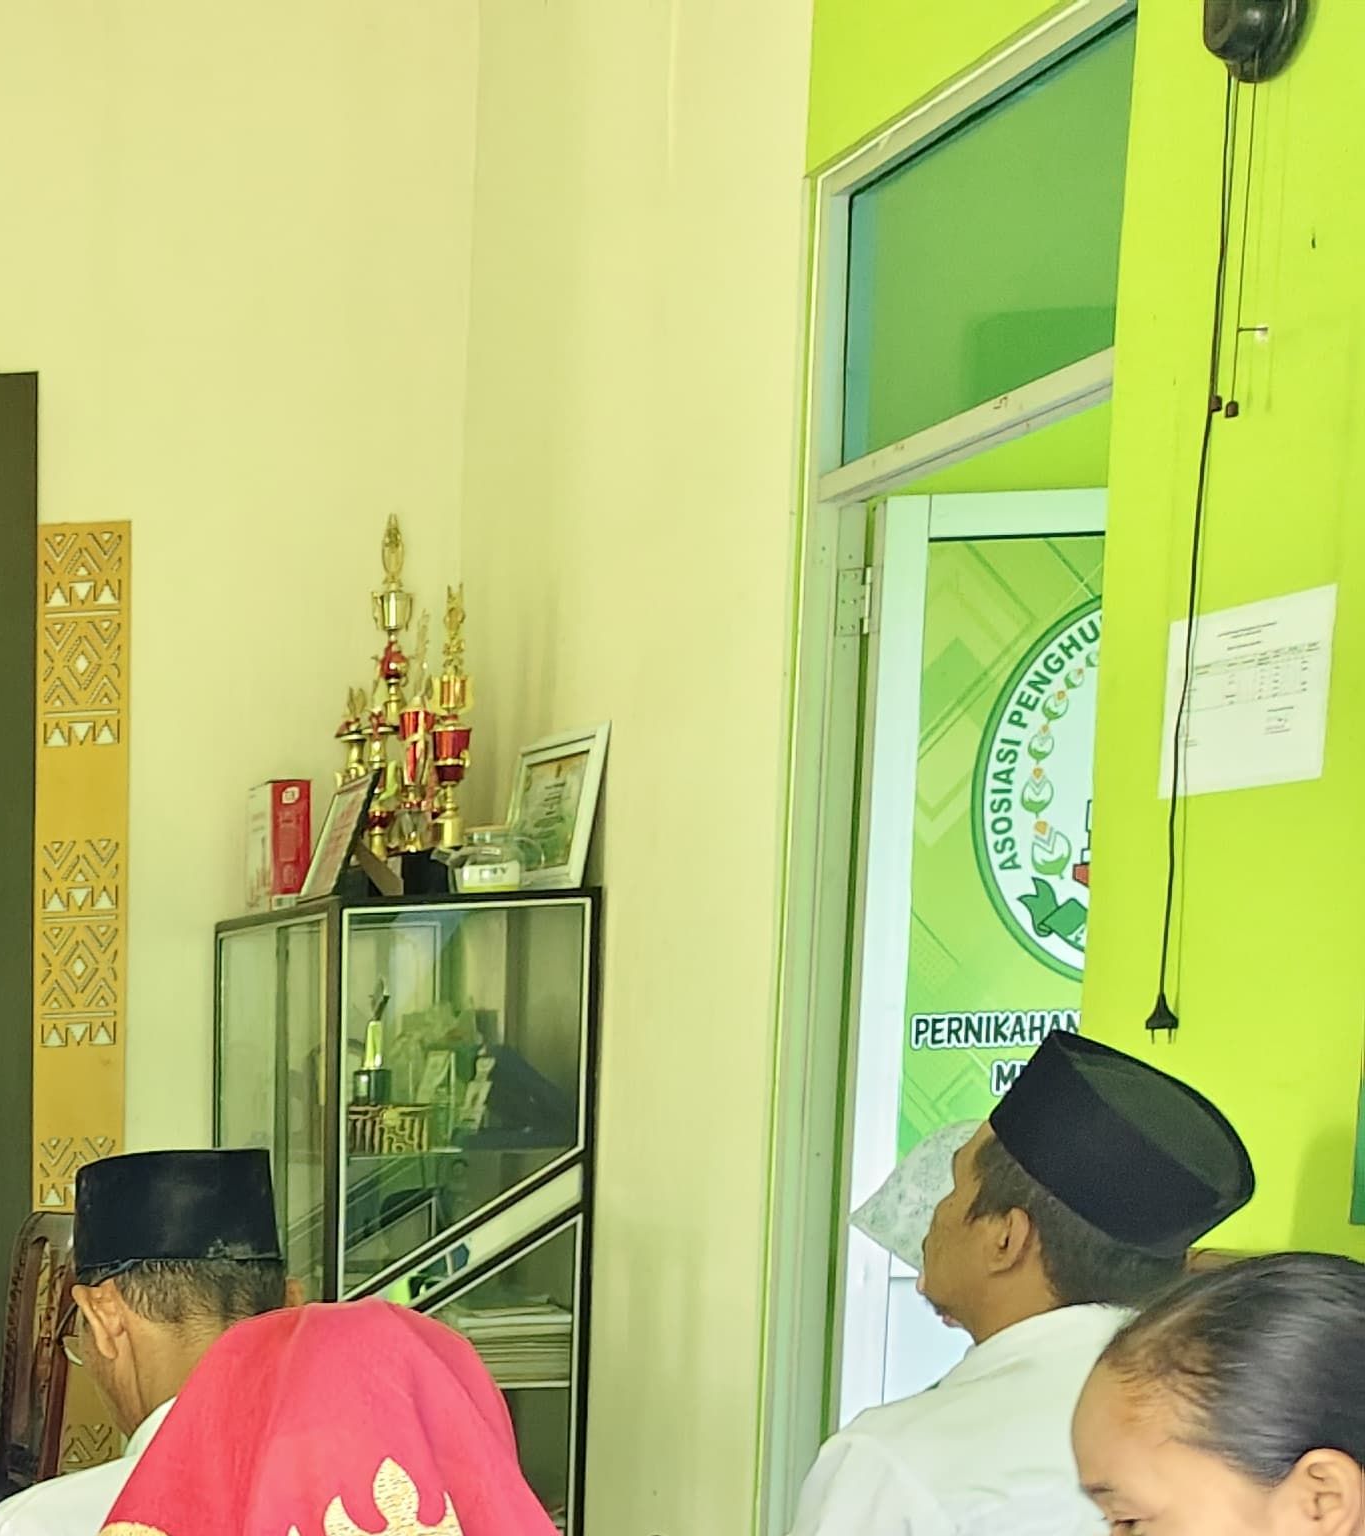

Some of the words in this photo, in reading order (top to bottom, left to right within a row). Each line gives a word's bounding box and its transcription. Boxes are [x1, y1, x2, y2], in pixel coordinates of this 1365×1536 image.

[990, 738, 1022, 871] ASOSIASI
[1007, 614, 1102, 730] PENGHU
[995, 1063, 1026, 1092] M
